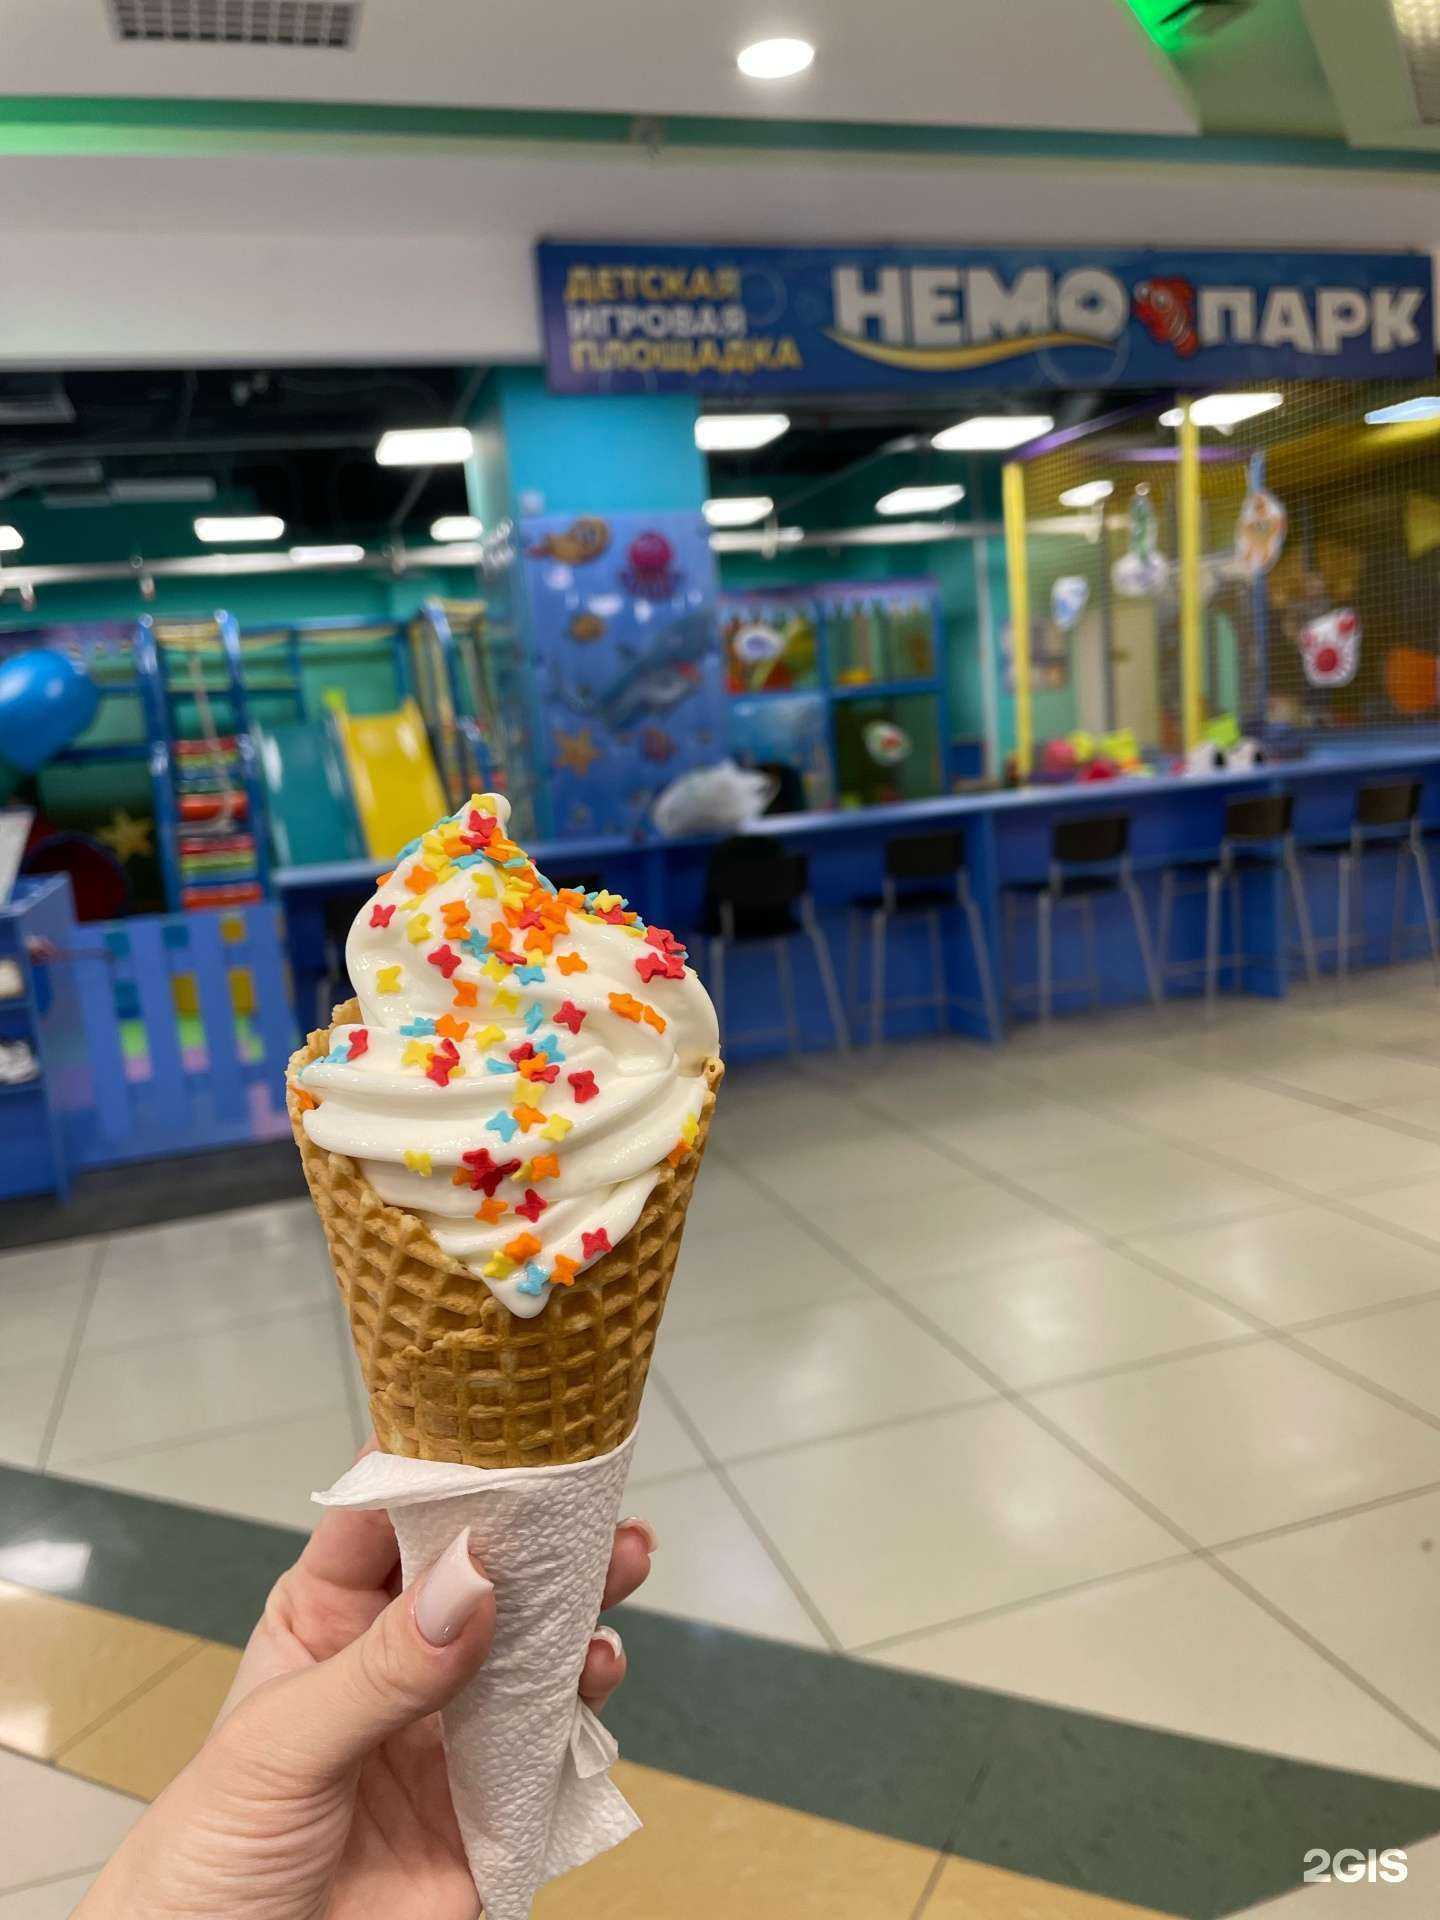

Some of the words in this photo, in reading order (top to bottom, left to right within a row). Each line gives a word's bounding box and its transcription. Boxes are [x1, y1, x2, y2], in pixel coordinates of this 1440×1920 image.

[565, 266, 741, 302] ДЕТСКАЯ
[566, 303, 747, 338] ИГРОВАЯ
[832, 266, 1129, 346] НЕМО
[1199, 285, 1424, 355] ПАРК
[571, 338, 802, 374] ПЛОЩАДКА
